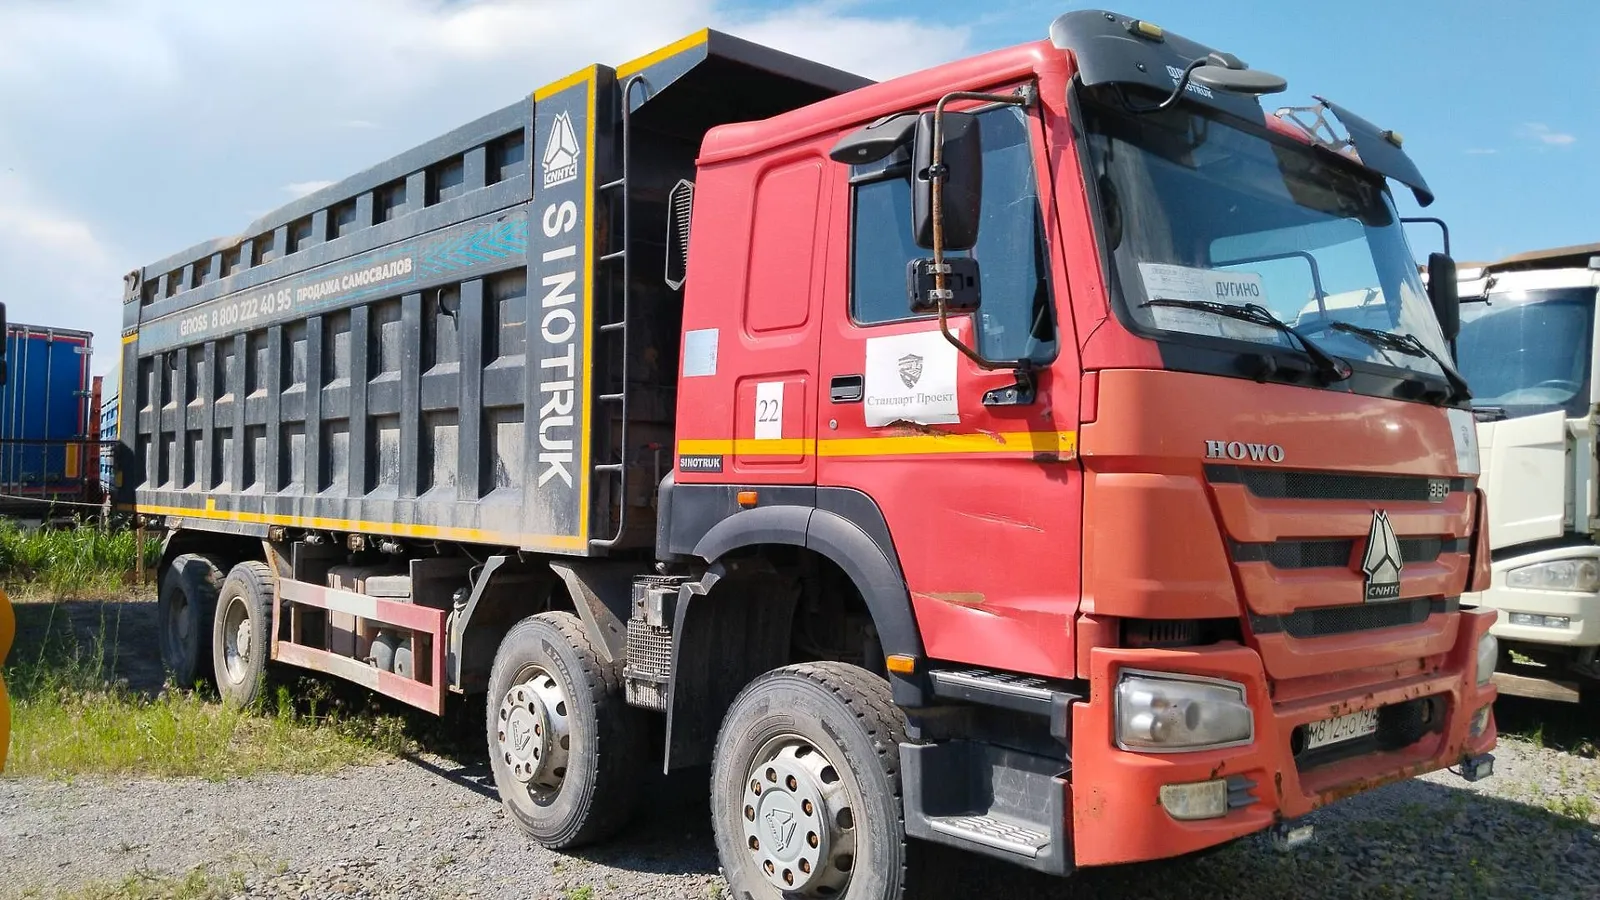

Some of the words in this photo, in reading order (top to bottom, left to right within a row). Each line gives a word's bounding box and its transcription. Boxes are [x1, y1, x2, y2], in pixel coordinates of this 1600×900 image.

[546, 166, 576, 184] CNHTC
[296, 278, 340, 302] ПРОДАЖА
[342, 258, 412, 290] САМОСВАЛОВ
[1215, 281, 1260, 298] ДУГИНО
[180, 314, 208, 336] GROSS
[211, 311, 219, 329] 8
[219, 306, 238, 327] 800
[239, 299, 258, 322] 222
[260, 294, 275, 315] 40
[276, 288, 292, 312] 95
[538, 200, 578, 489] SINOTRUK
[867, 395, 914, 407] Стандарт
[916, 392, 954, 405] Проект
[758, 399, 779, 422] 22
[1205, 440, 1285, 463] HOWO
[680, 458, 720, 468] SINOTRUK
[1368, 585, 1399, 597] CNHTC
